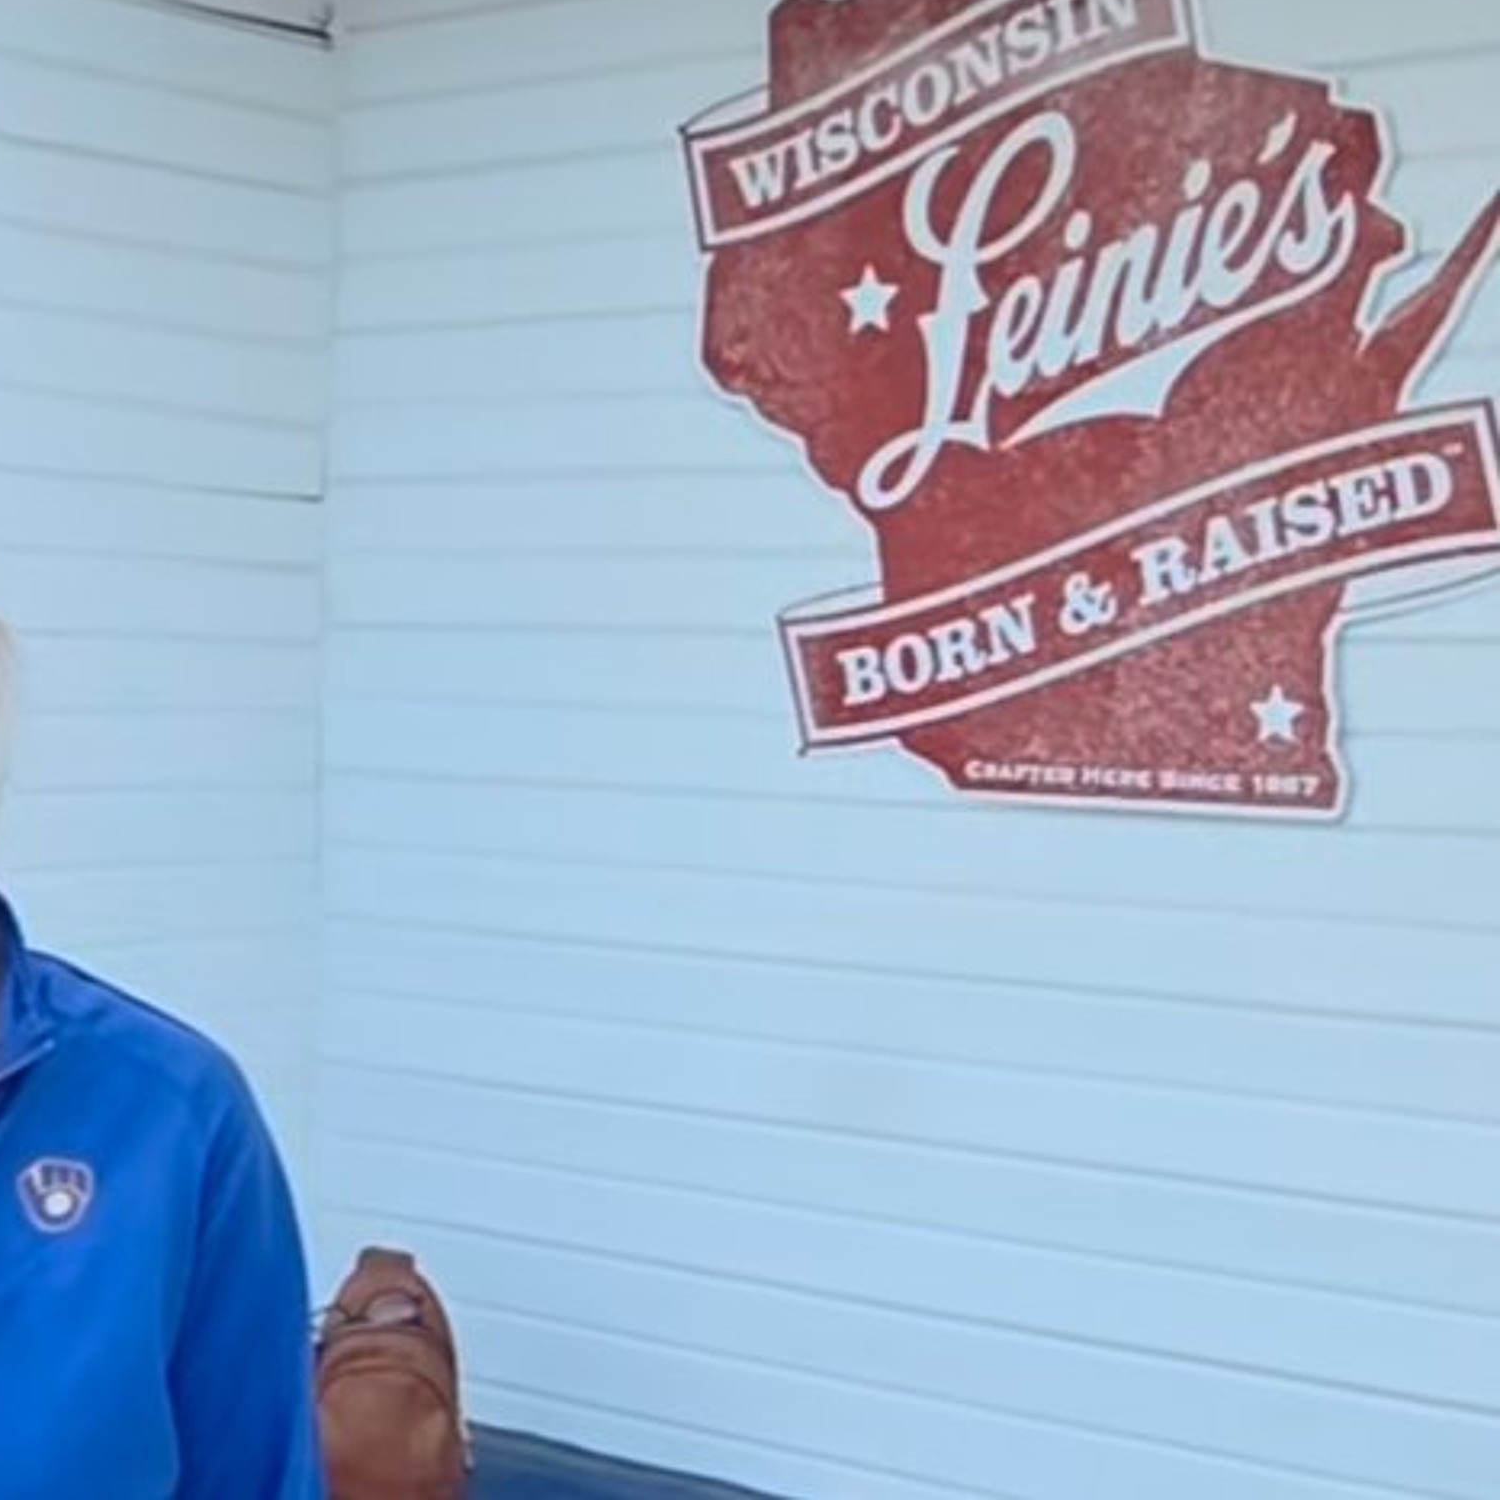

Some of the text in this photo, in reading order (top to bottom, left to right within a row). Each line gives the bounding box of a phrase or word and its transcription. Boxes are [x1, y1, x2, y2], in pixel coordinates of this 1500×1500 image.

[857, 111, 1356, 510] Leinie's
[836, 452, 1453, 705] BORN & RAISED
[964, 759, 1076, 785] CRAFTED
[1080, 765, 1153, 789] HERE
[1157, 767, 1242, 791] SINCE
